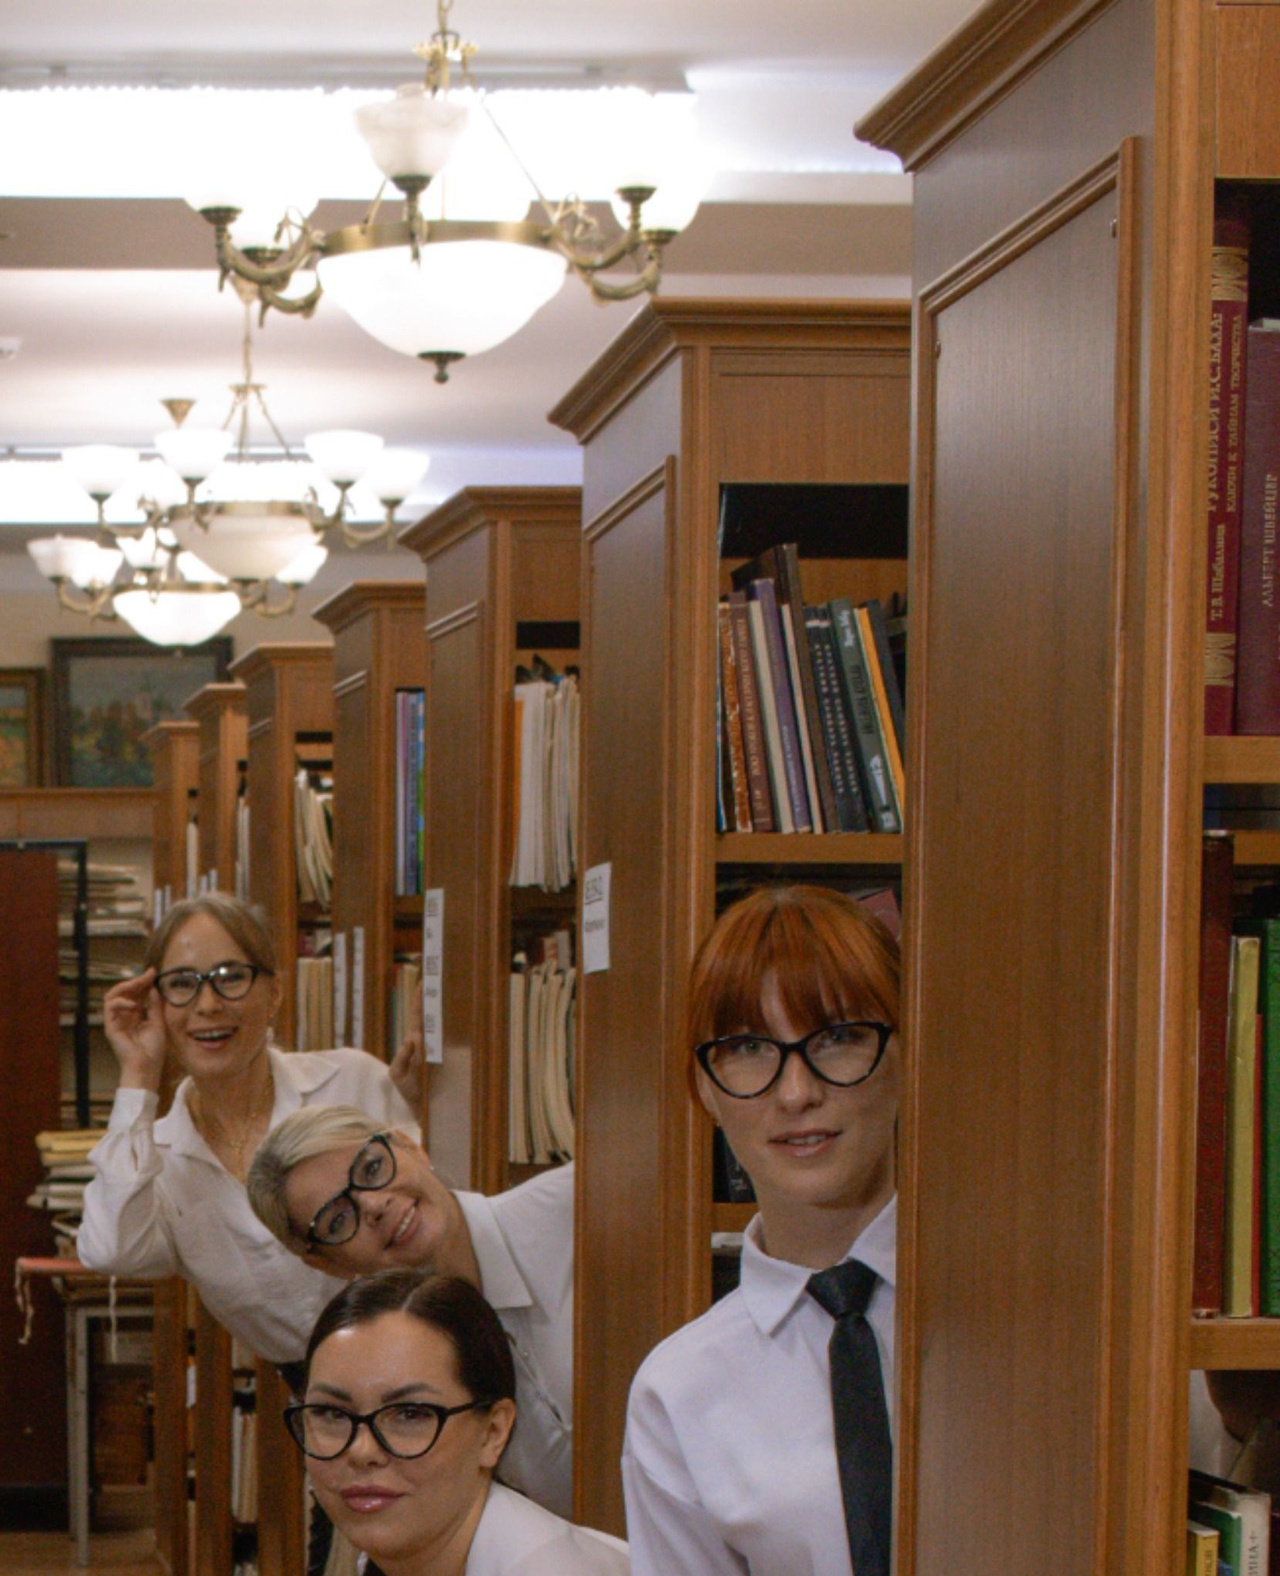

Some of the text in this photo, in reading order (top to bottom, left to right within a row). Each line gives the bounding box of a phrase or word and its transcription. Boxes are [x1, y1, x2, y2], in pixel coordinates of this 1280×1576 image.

[1225, 314, 1243, 513] КЛЮЧИ К ТАЙНАМ ТВОРЧЕСТВА
[1210, 522, 1226, 620] Т. В. Шабалина
[1258, 473, 1280, 607] АЛЬБЕРТ ШВЕЙЦЕР
